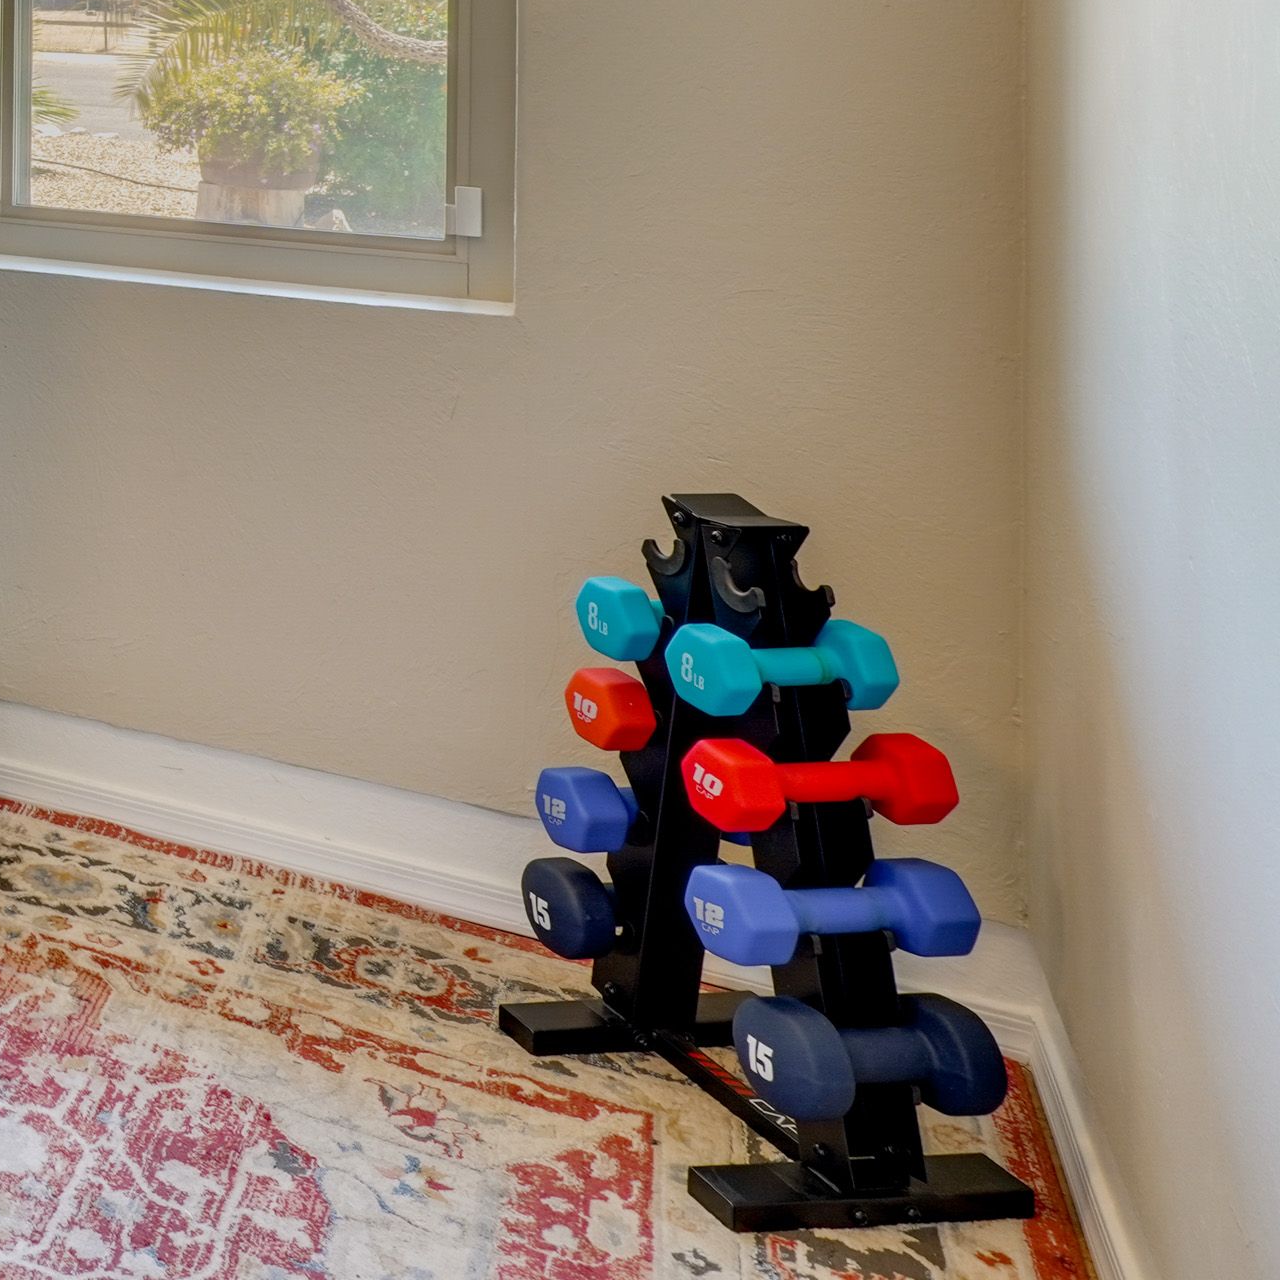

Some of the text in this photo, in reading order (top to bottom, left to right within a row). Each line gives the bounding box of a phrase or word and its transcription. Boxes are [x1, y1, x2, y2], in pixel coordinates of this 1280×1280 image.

[573, 691, 598, 720] 10
[693, 762, 723, 796] 10
[543, 793, 567, 820] 12
[529, 891, 551, 931] 15
[693, 896, 724, 929] 12
[746, 1034, 774, 1082] 15
